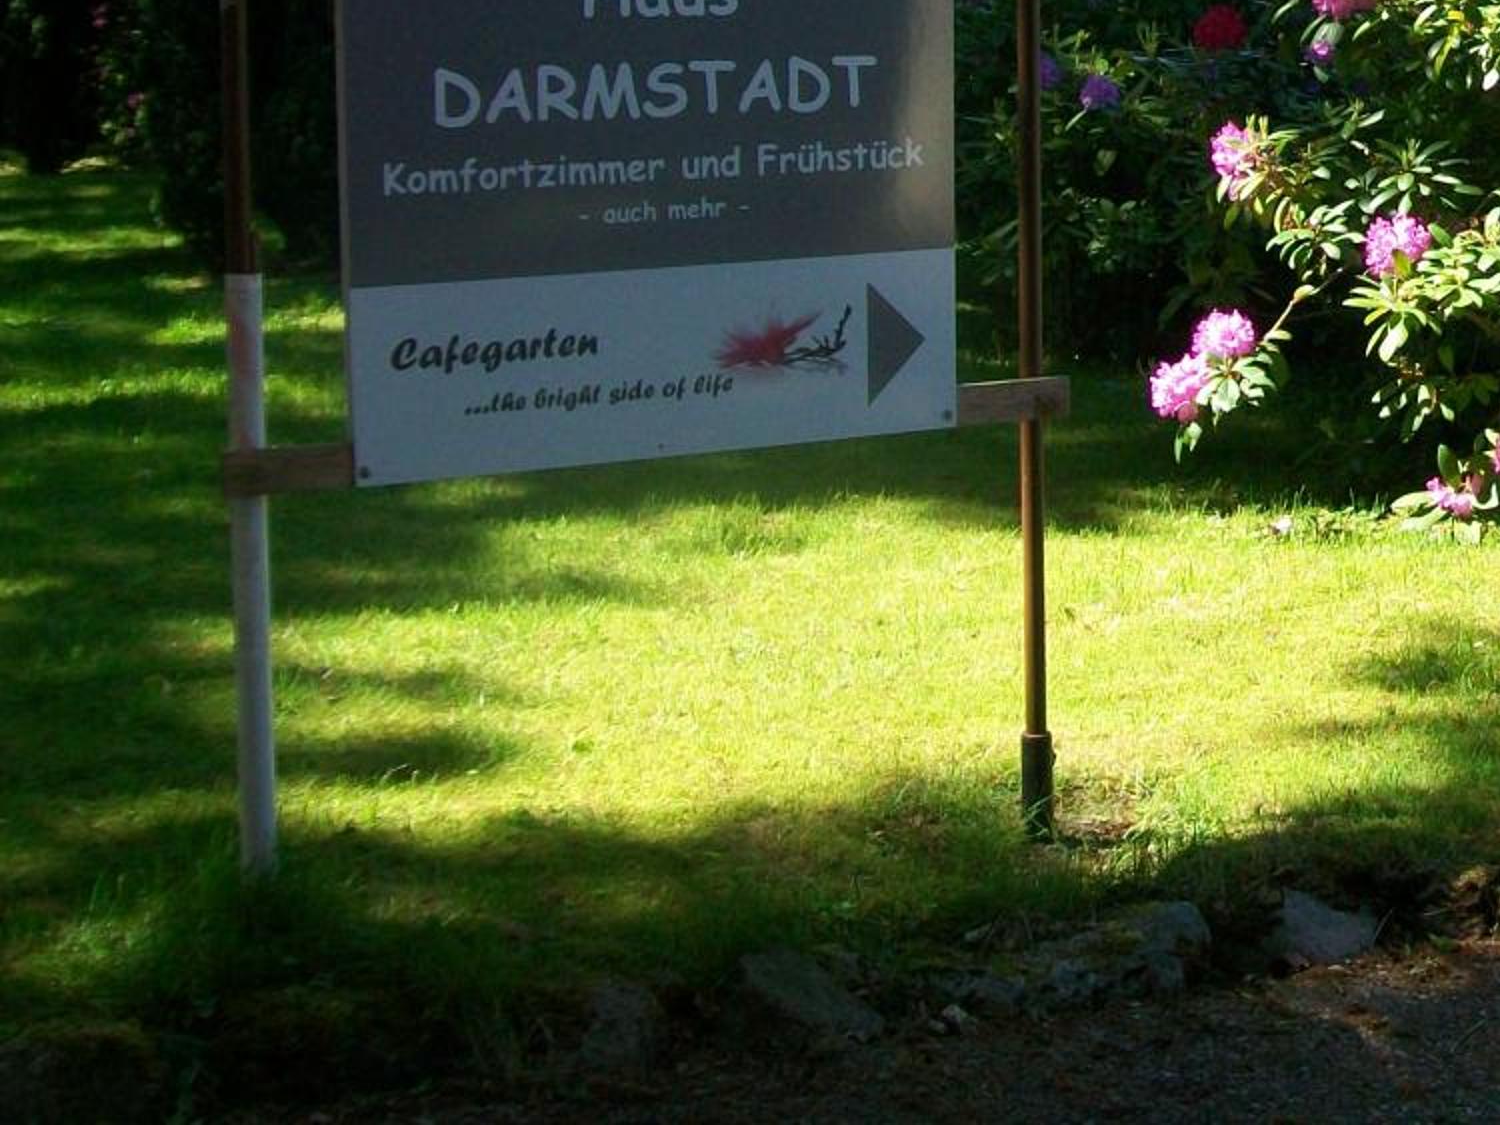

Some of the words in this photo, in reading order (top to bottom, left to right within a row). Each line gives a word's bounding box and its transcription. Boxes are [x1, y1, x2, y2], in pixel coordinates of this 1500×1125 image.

[433, 55, 877, 128] DARMSTADT
[383, 157, 664, 196] Komfortzimmer
[681, 145, 741, 179] und
[757, 137, 924, 174] Frühstück
[603, 201, 657, 224] auch
[668, 198, 726, 221] mehr
[390, 328, 599, 375] Cafegarten
[534, 385, 600, 411] bright
[609, 379, 655, 405] side
[662, 376, 687, 401] of
[694, 374, 734, 399] life
